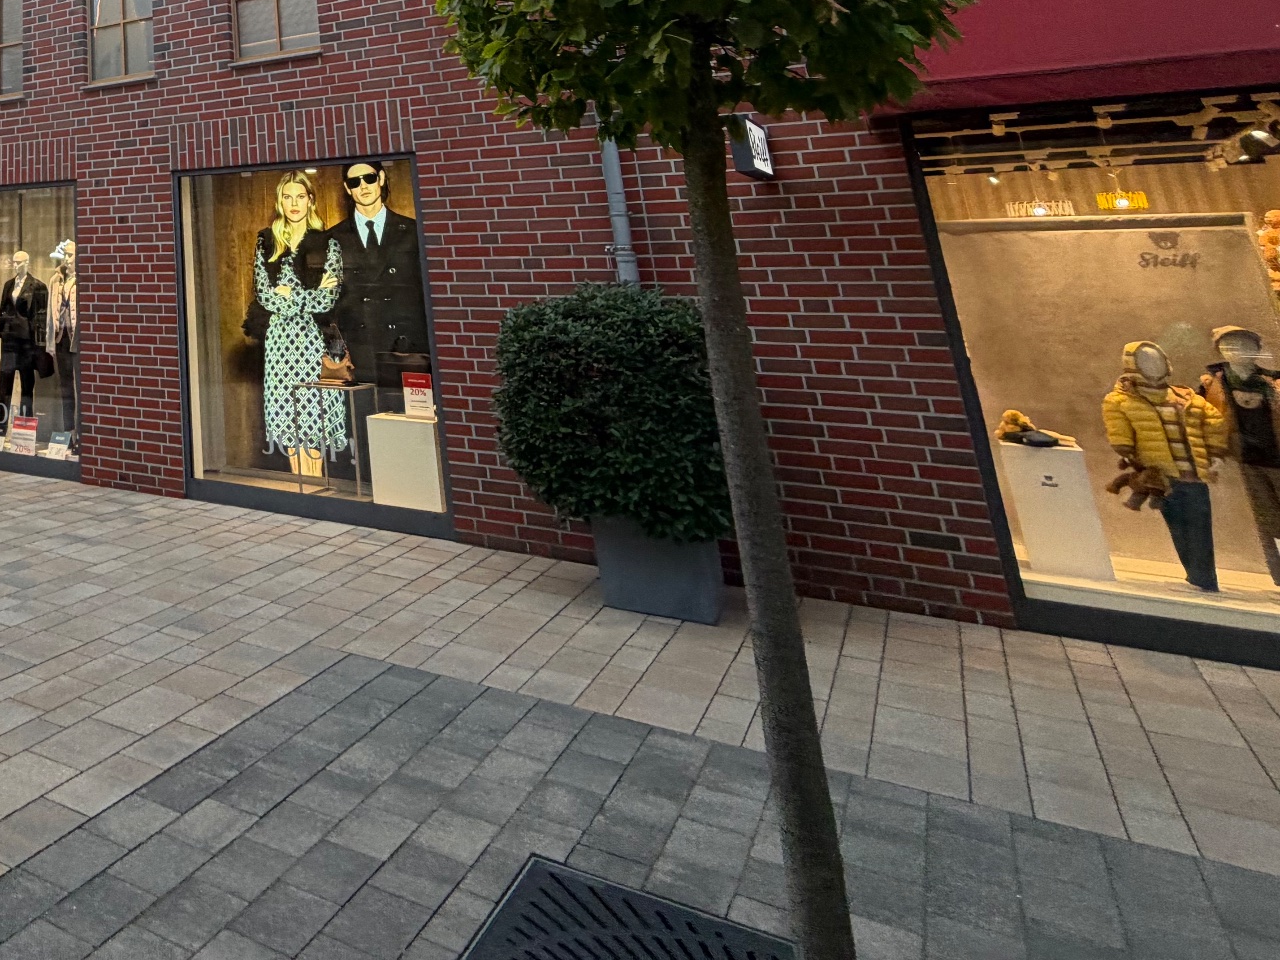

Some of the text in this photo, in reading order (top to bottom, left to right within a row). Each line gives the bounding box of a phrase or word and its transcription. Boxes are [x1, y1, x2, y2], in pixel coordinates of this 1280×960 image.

[1138, 251, 1200, 270] Steiff
[410, 388, 427, 397] 20%
[14, 444, 31, 454] 20%
[261, 429, 357, 466] JOOP!
